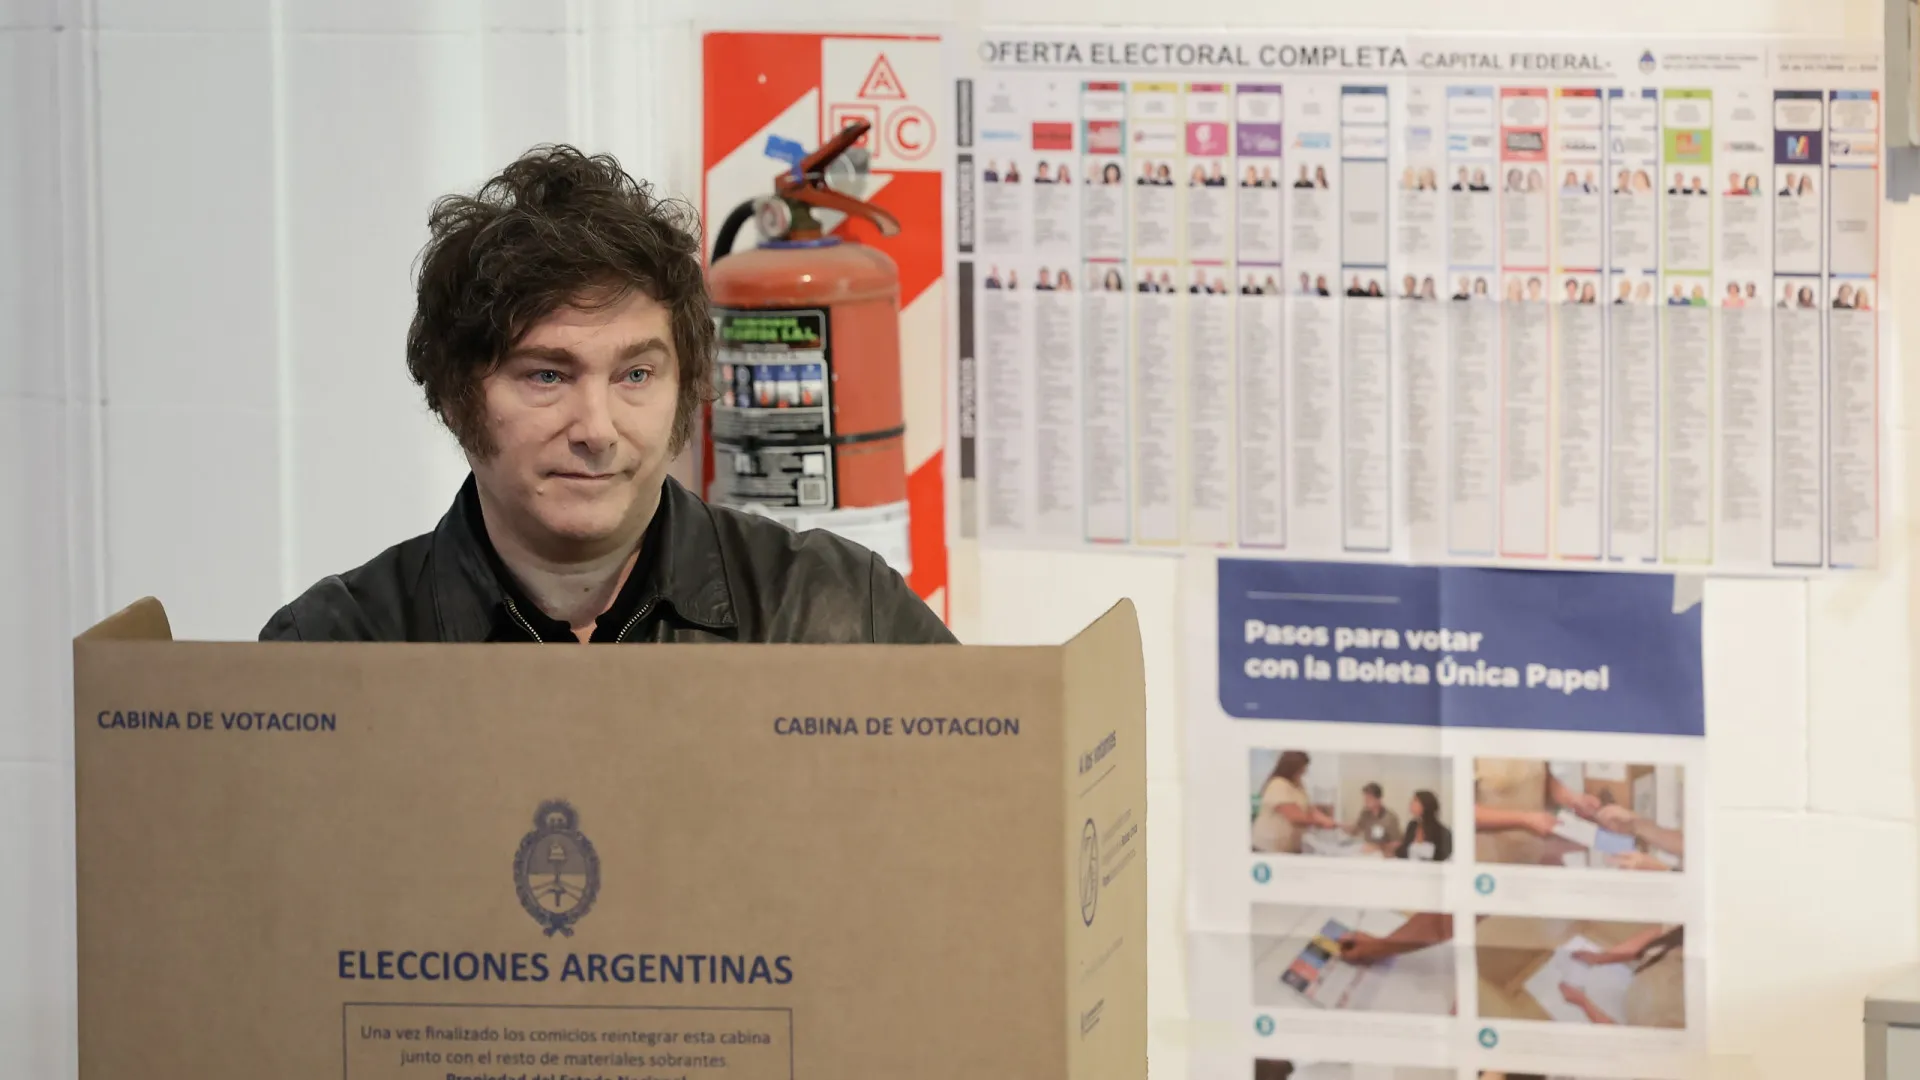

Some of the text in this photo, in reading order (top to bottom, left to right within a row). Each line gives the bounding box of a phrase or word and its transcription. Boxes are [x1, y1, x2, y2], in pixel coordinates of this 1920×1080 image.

[979, 41, 1083, 64] OFERTA
[1091, 43, 1249, 66] ELECTORAL
[1258, 45, 1408, 67] COMPLETA
[873, 72, 892, 89] A
[896, 117, 920, 149] C
[1244, 619, 1483, 653] Pasos para votar
[1244, 654, 1609, 695] con la Boleta Única Papel
[97, 711, 336, 731] CABINA DE VOTACION
[774, 717, 1020, 736] CABINA DE VOTACION
[338, 951, 793, 985] ELECCIONES ARGENTINAS
[360, 1025, 771, 1046] Una vez finalizado los comicios reintegrar esta cabina
[400, 1050, 442, 1066] junto
[446, 1052, 474, 1065] con
[478, 1050, 492, 1065] el
[496, 1053, 536, 1066] resto
[540, 1051, 560, 1066] de
[564, 1052, 645, 1068] materiales
